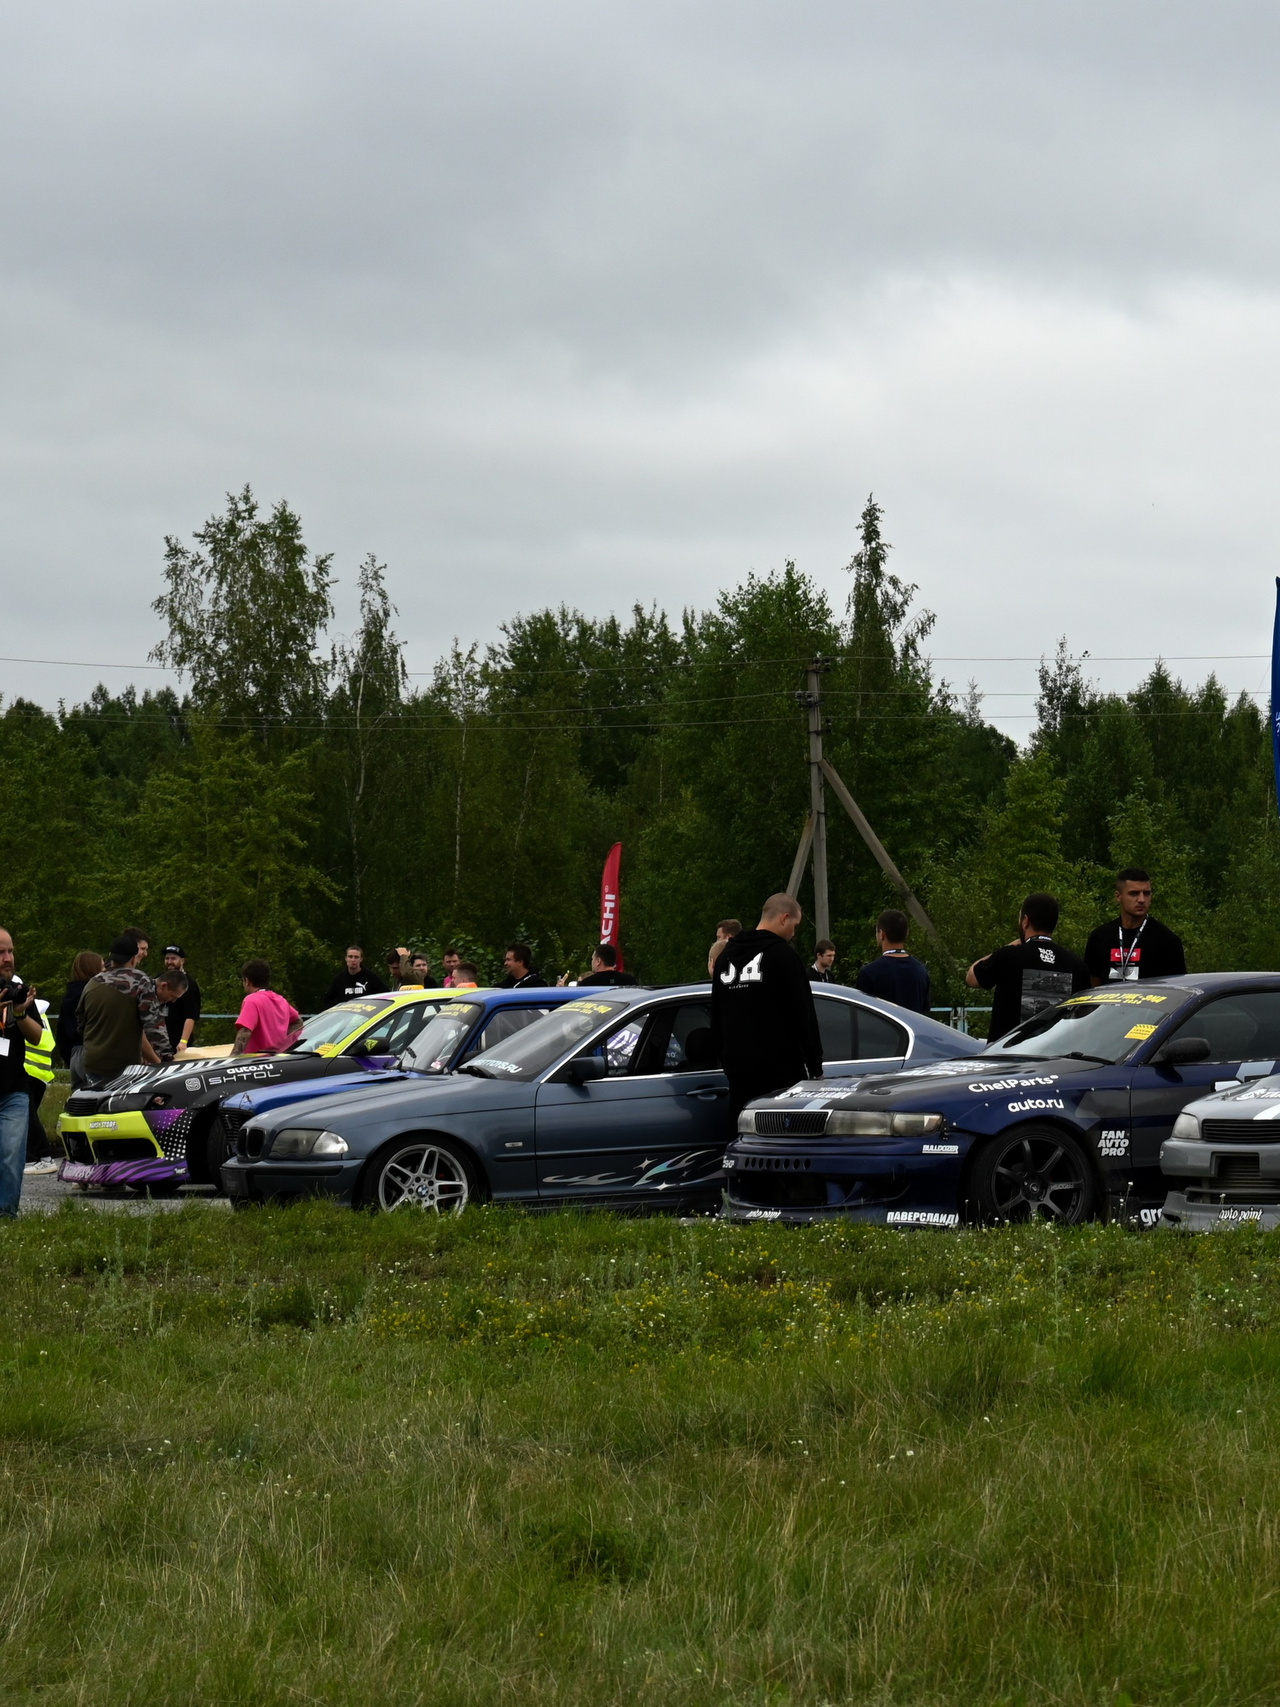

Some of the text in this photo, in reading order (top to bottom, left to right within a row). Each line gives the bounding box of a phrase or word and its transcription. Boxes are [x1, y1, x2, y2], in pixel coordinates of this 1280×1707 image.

[226, 1064, 274, 1075] auto.ru
[208, 1071, 281, 1085] SHTOL
[968, 1076, 1052, 1093] ChelParts
[1007, 1098, 1065, 1113] auto.ru
[1101, 1130, 1126, 1139] FAN
[922, 1144, 959, 1152] BULLDOZER
[1097, 1139, 1129, 1148] AVTO
[1101, 1148, 1125, 1157] PRO
